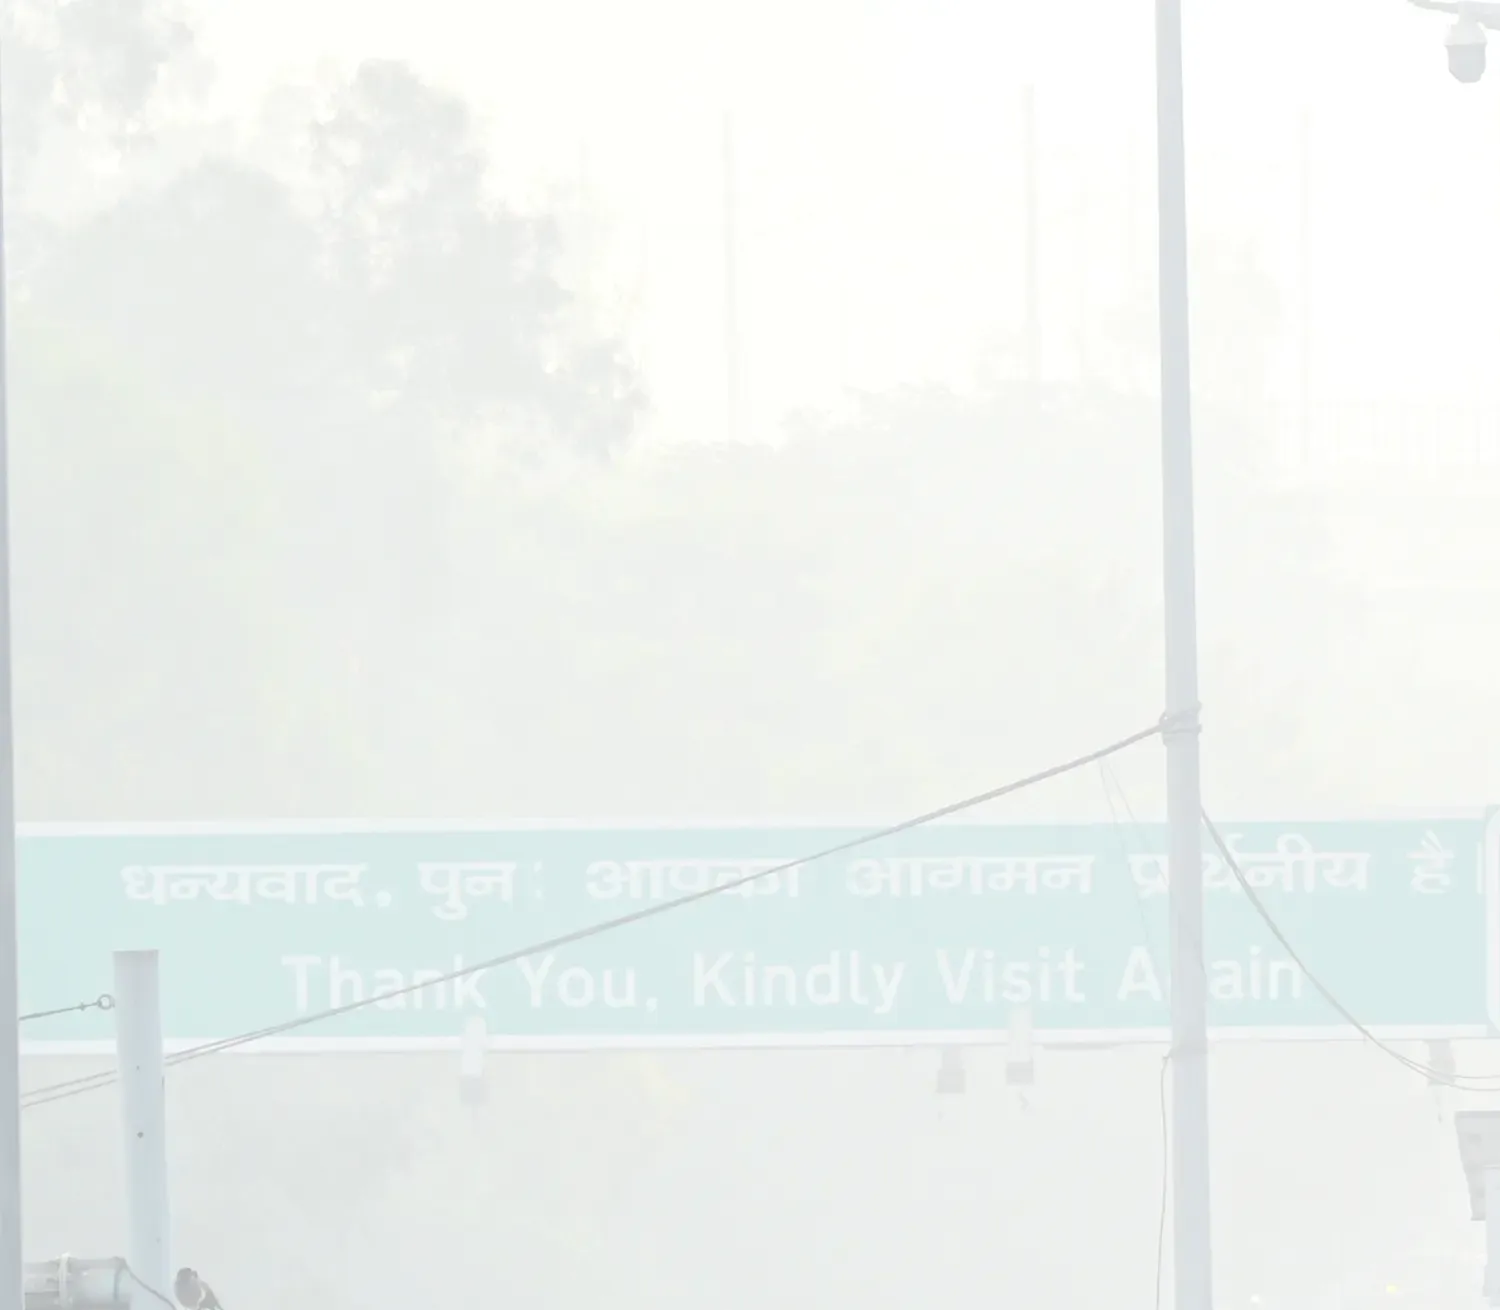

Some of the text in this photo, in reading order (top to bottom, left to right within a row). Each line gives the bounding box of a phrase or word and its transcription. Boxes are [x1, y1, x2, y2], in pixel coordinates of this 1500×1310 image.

[845, 855, 1096, 898] आगमन
[280, 946, 1301, 1014] Thank You, Kindly Visit Aain
